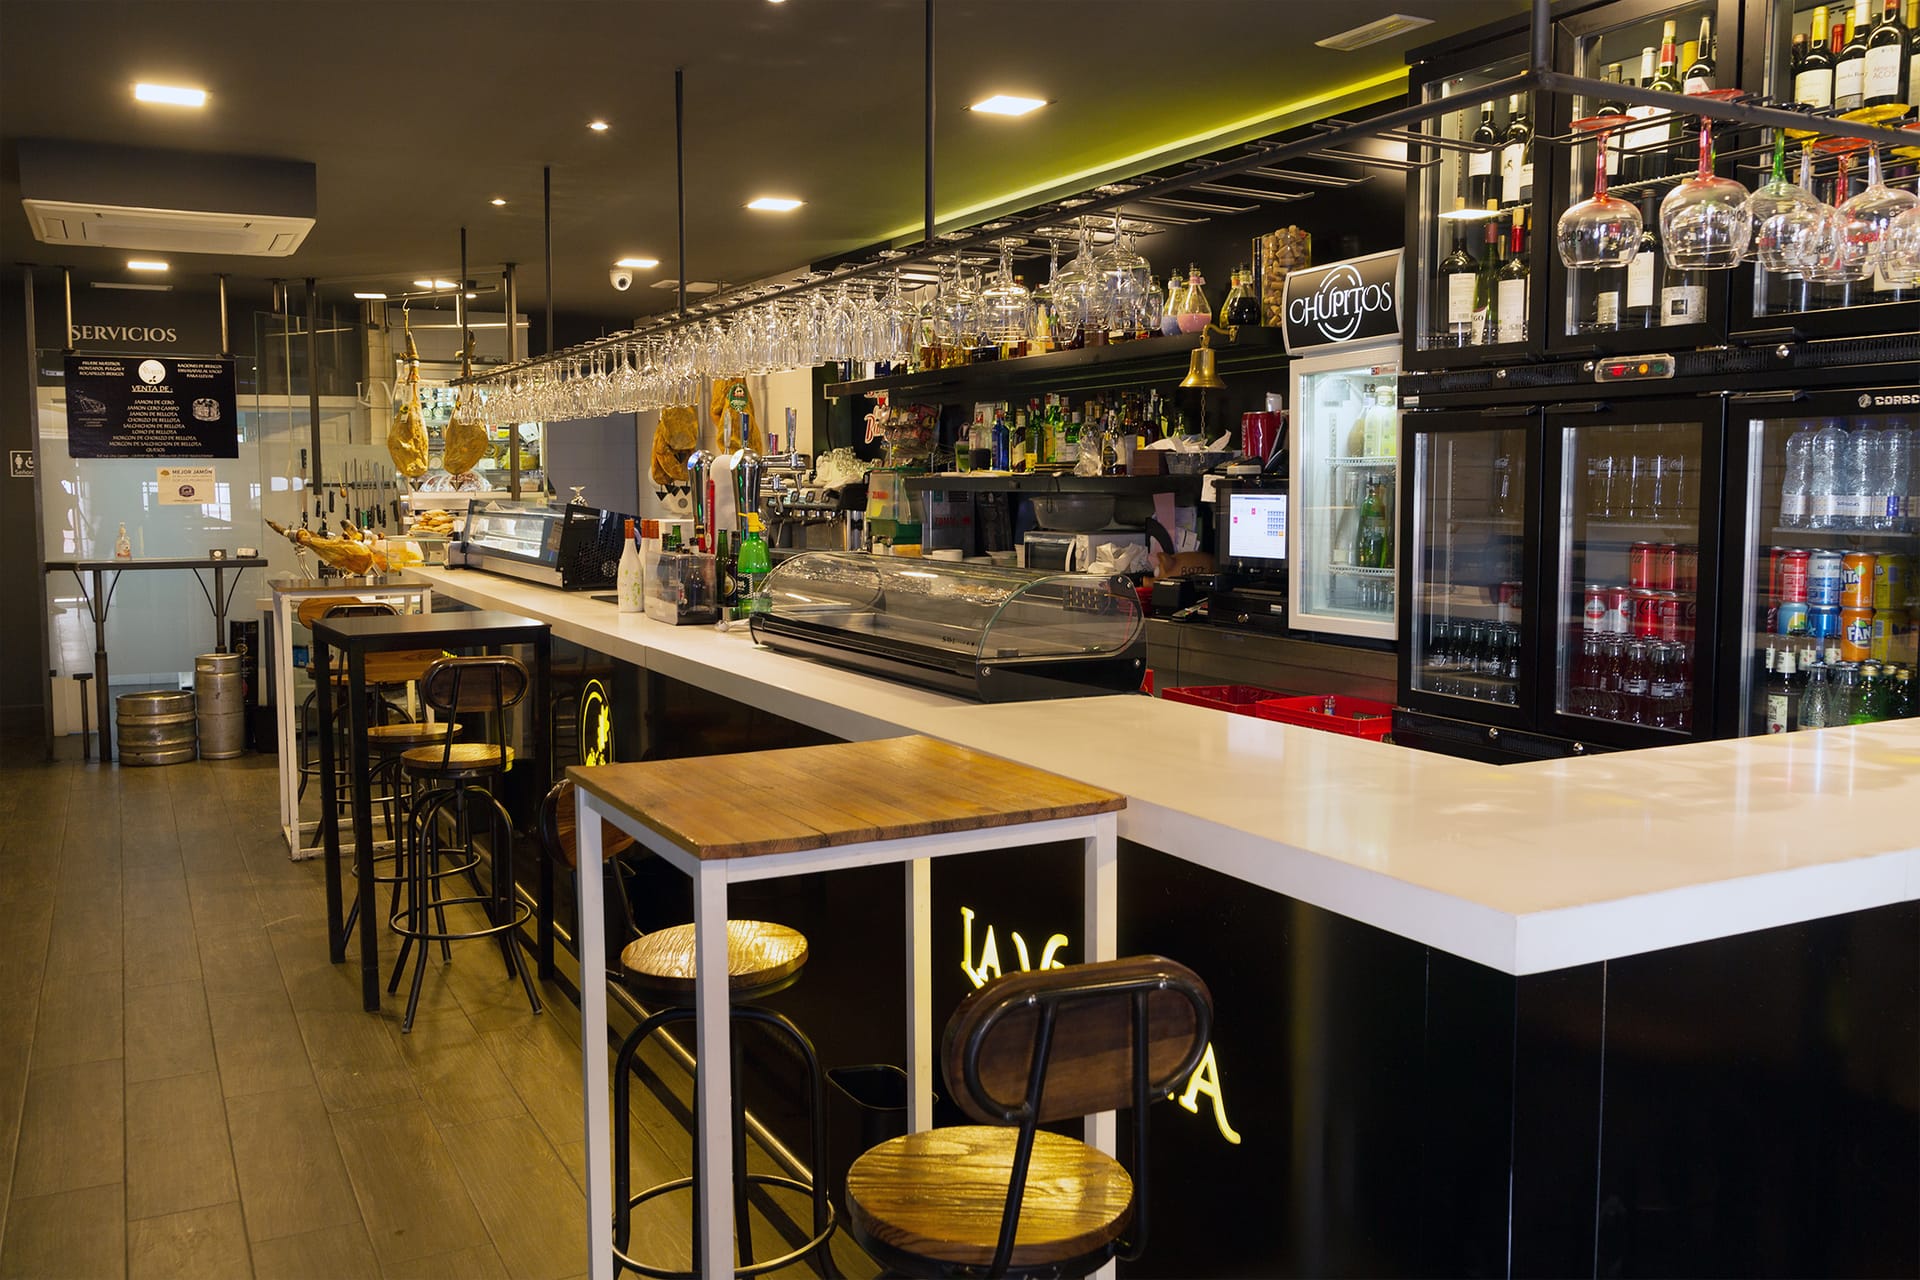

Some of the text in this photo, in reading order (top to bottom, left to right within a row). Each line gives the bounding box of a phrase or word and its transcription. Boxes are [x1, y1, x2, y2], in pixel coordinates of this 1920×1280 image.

[1289, 281, 1392, 327] CHUPITOS
[72, 325, 177, 342] SERVICIOS
[1847, 626, 1872, 641] FAN
